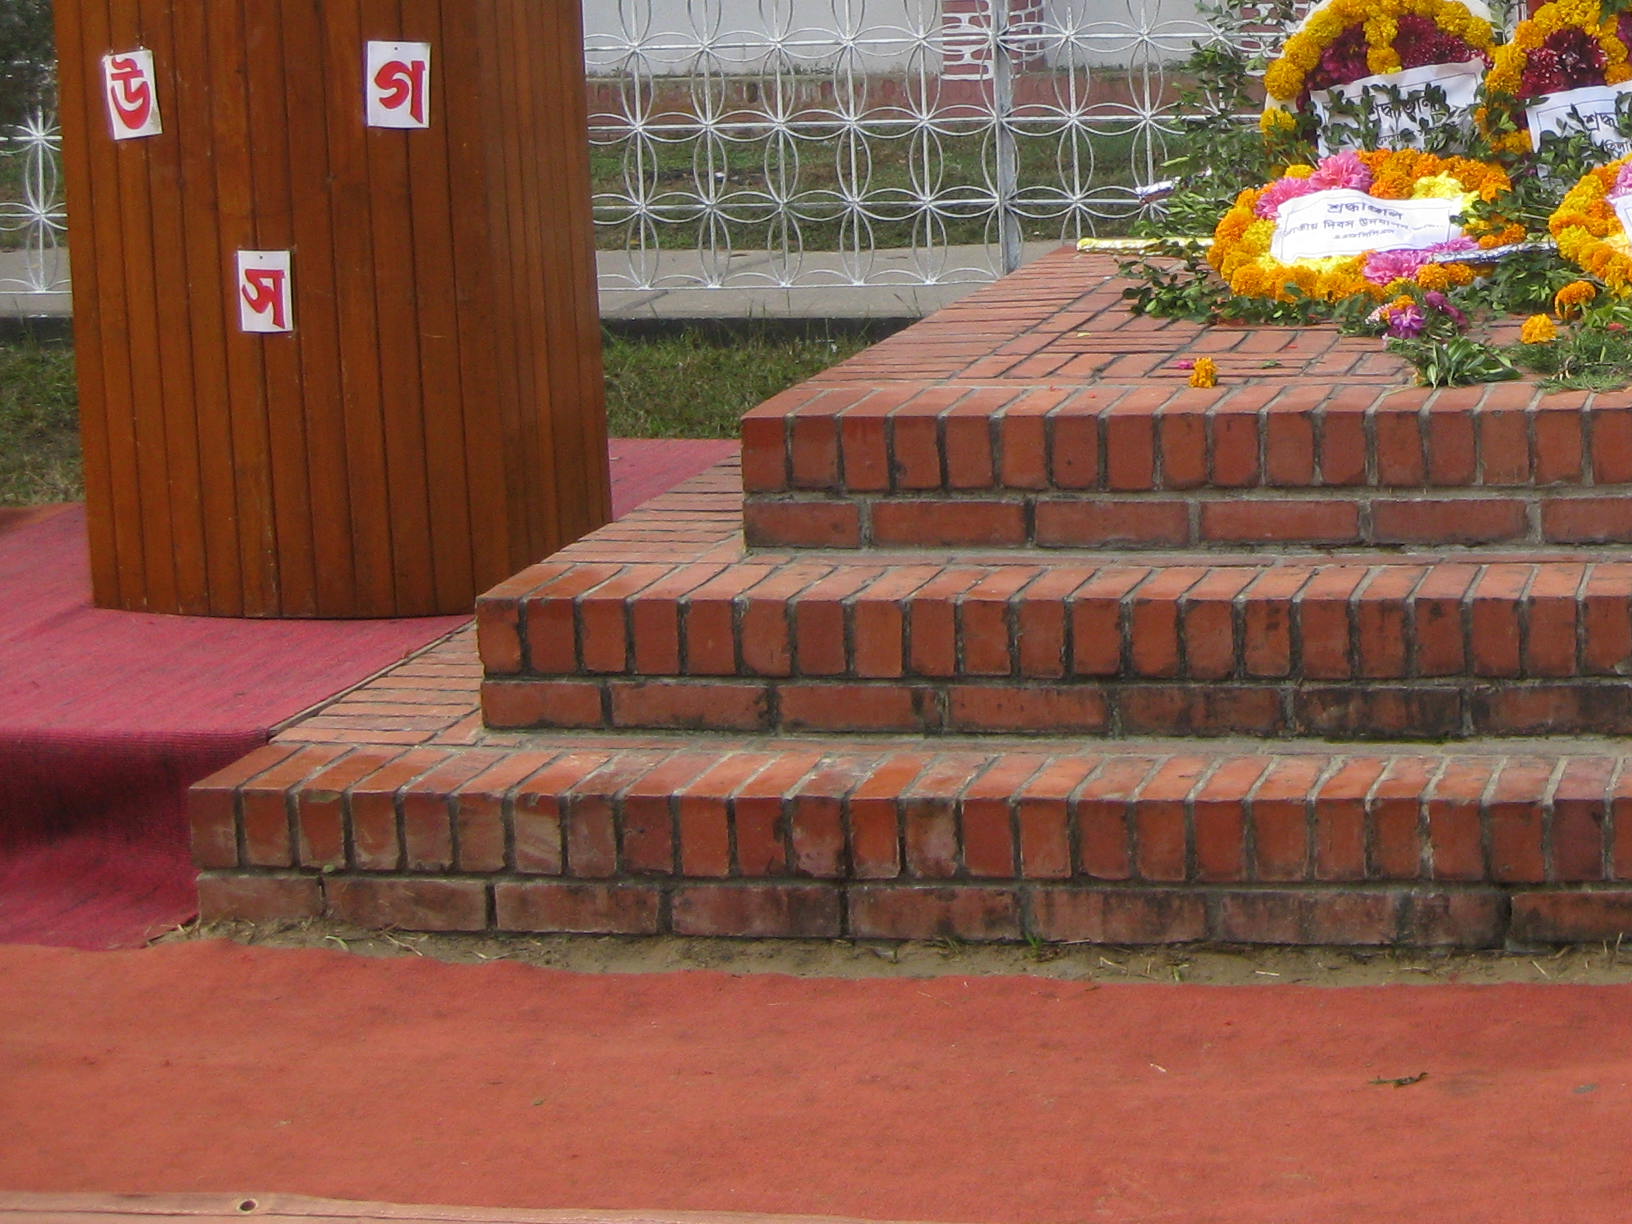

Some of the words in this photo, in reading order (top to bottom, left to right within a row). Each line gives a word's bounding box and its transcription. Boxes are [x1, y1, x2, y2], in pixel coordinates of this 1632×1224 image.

[111, 57, 150, 129] উ
[374, 60, 426, 124] গ
[241, 269, 286, 329] স
